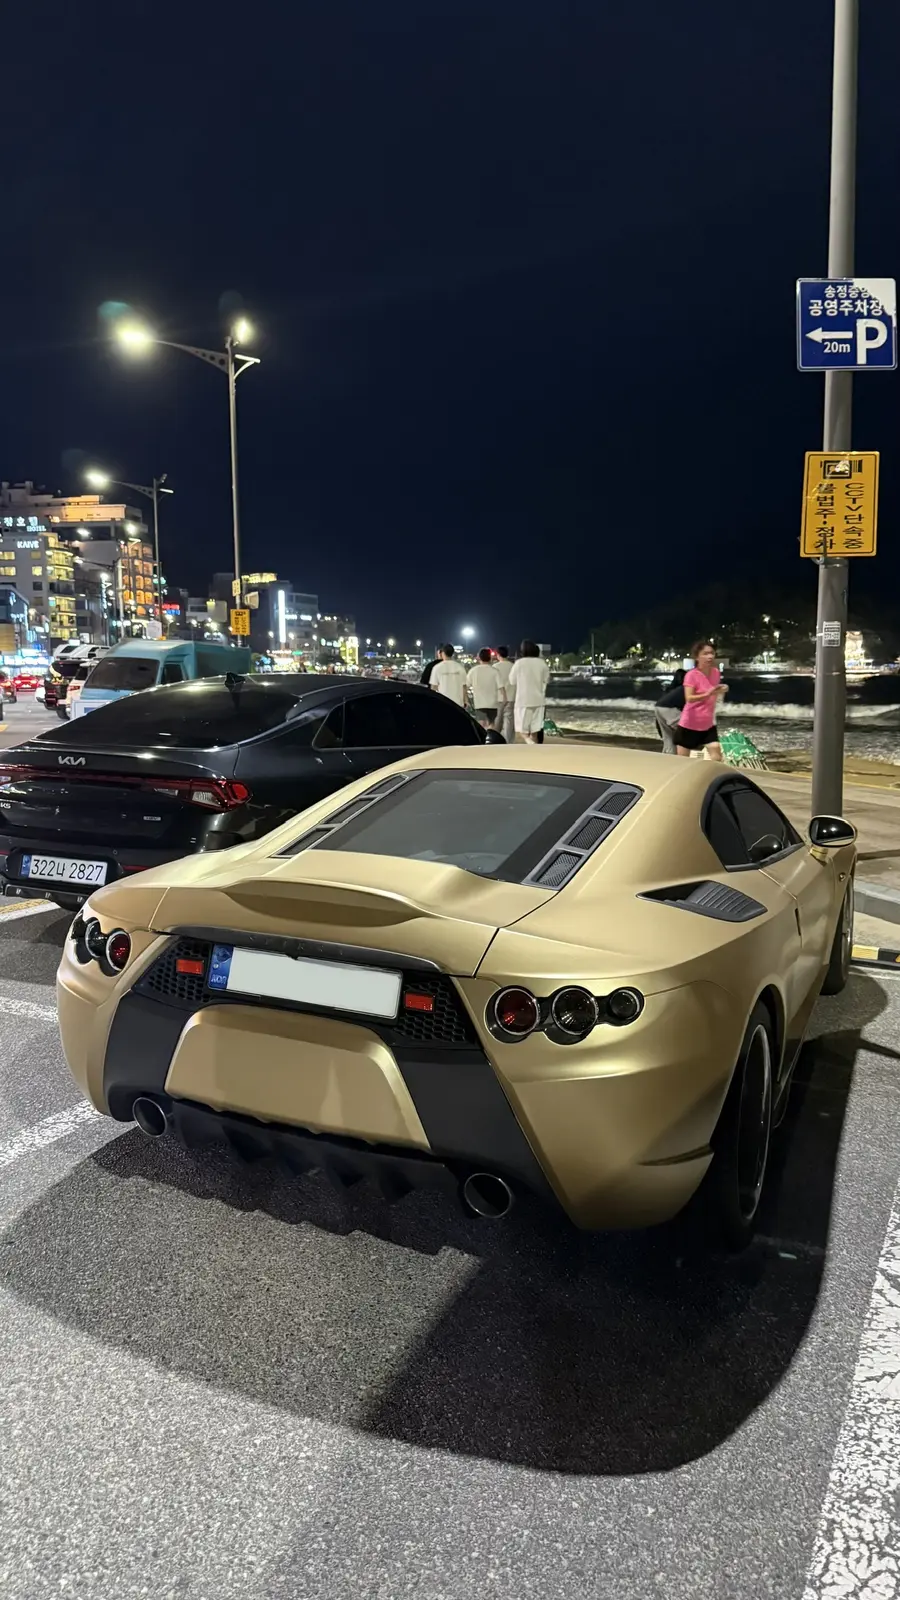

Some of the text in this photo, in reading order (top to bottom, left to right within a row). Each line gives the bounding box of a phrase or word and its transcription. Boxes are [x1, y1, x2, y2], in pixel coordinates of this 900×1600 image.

[808, 299, 884, 316] 공영주차장
[823, 341, 851, 353] 20m
[856, 318, 888, 365] P
[68, 862, 104, 882] 2827
